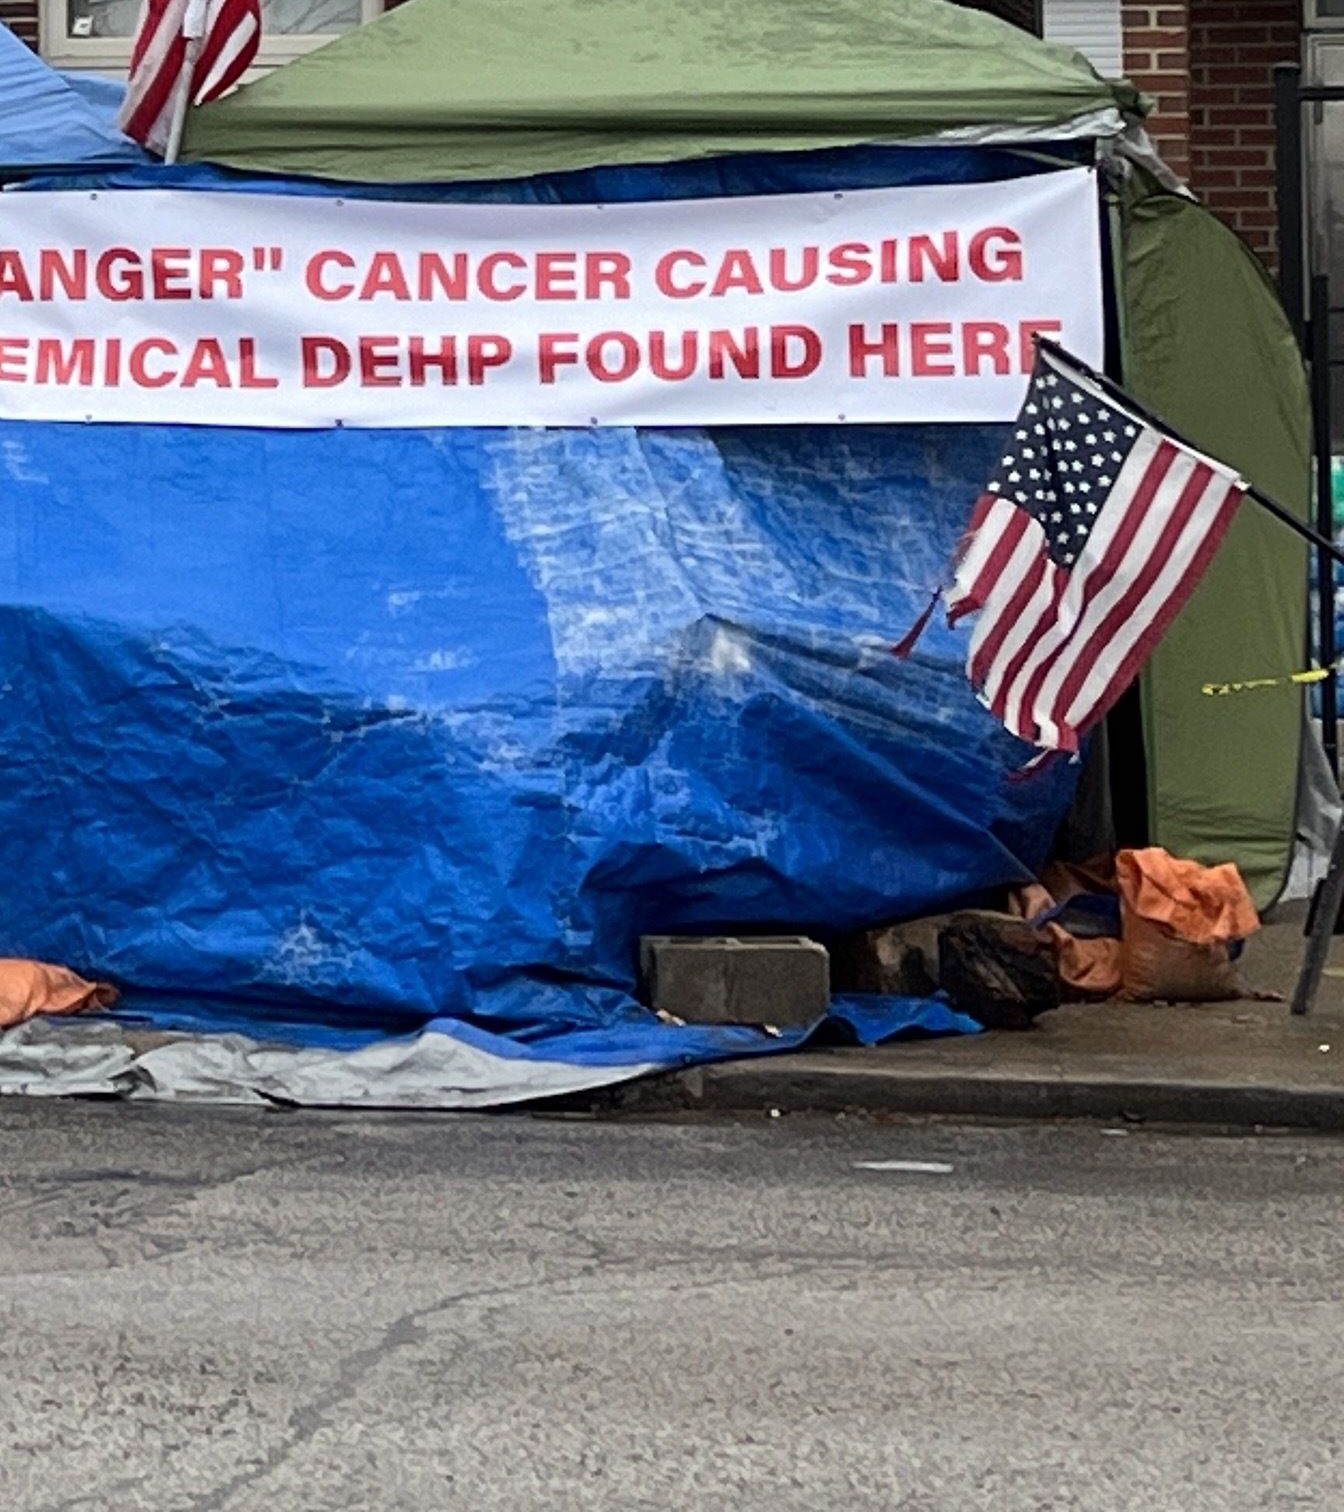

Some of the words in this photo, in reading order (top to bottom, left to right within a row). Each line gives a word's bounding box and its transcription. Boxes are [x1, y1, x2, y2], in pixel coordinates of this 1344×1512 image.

[304, 248, 631, 302] CANCER
[654, 225, 1024, 300] CAUSING
[301, 333, 512, 387] DEHP
[537, 324, 823, 386] FOUND
